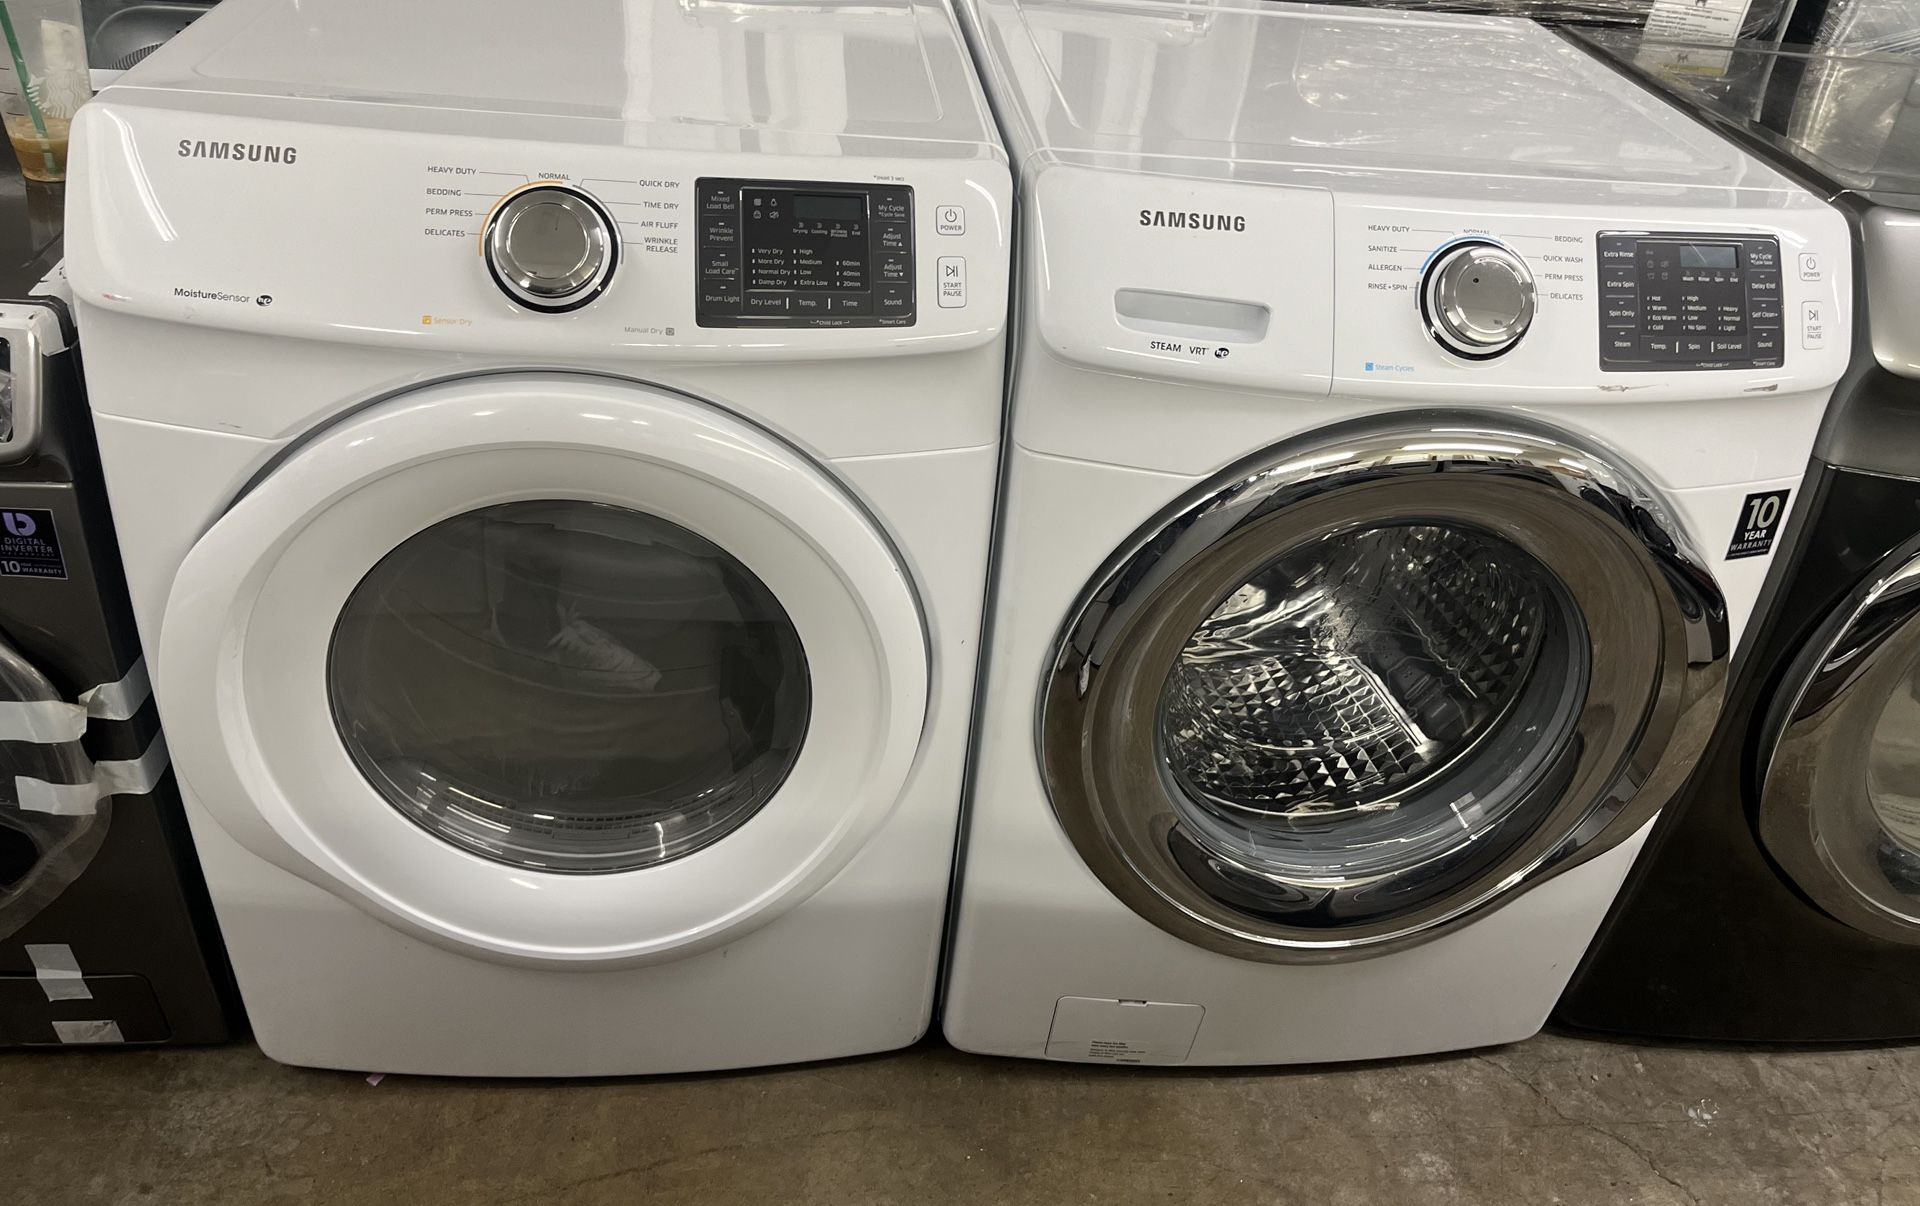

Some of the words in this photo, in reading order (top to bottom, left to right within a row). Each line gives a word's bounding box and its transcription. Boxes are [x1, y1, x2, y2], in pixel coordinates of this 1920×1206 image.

[178, 140, 296, 164] SAMSUNG
[538, 172, 571, 180] NORMAL
[426, 188, 462, 196] BEDDING
[450, 209, 473, 217] PRESS
[1140, 210, 1246, 232] SAMSUNG
[424, 228, 464, 238] DELICATES
[644, 237, 678, 245] WRINKLE
[1554, 236, 1583, 244] BEDDING
[646, 246, 678, 254] RELEASE
[1368, 264, 1402, 272] ALLERGEN
[174, 288, 250, 303] MoistureSensor
[1550, 292, 1584, 301] DELICATES
[798, 299, 816, 307] Temp.
[1622, 310, 1635, 318] Only
[460, 318, 472, 326] Dry
[624, 326, 649, 334] Manual
[1150, 341, 1182, 352] STEAM
[1746, 495, 1780, 530] 10
[1744, 530, 1768, 541] YEAR
[4, 537, 46, 546] DIGITAL
[1730, 539, 1772, 552] WARRANTY
[0, 544, 54, 554] INVERTER
[1, 560, 21, 574] 10
